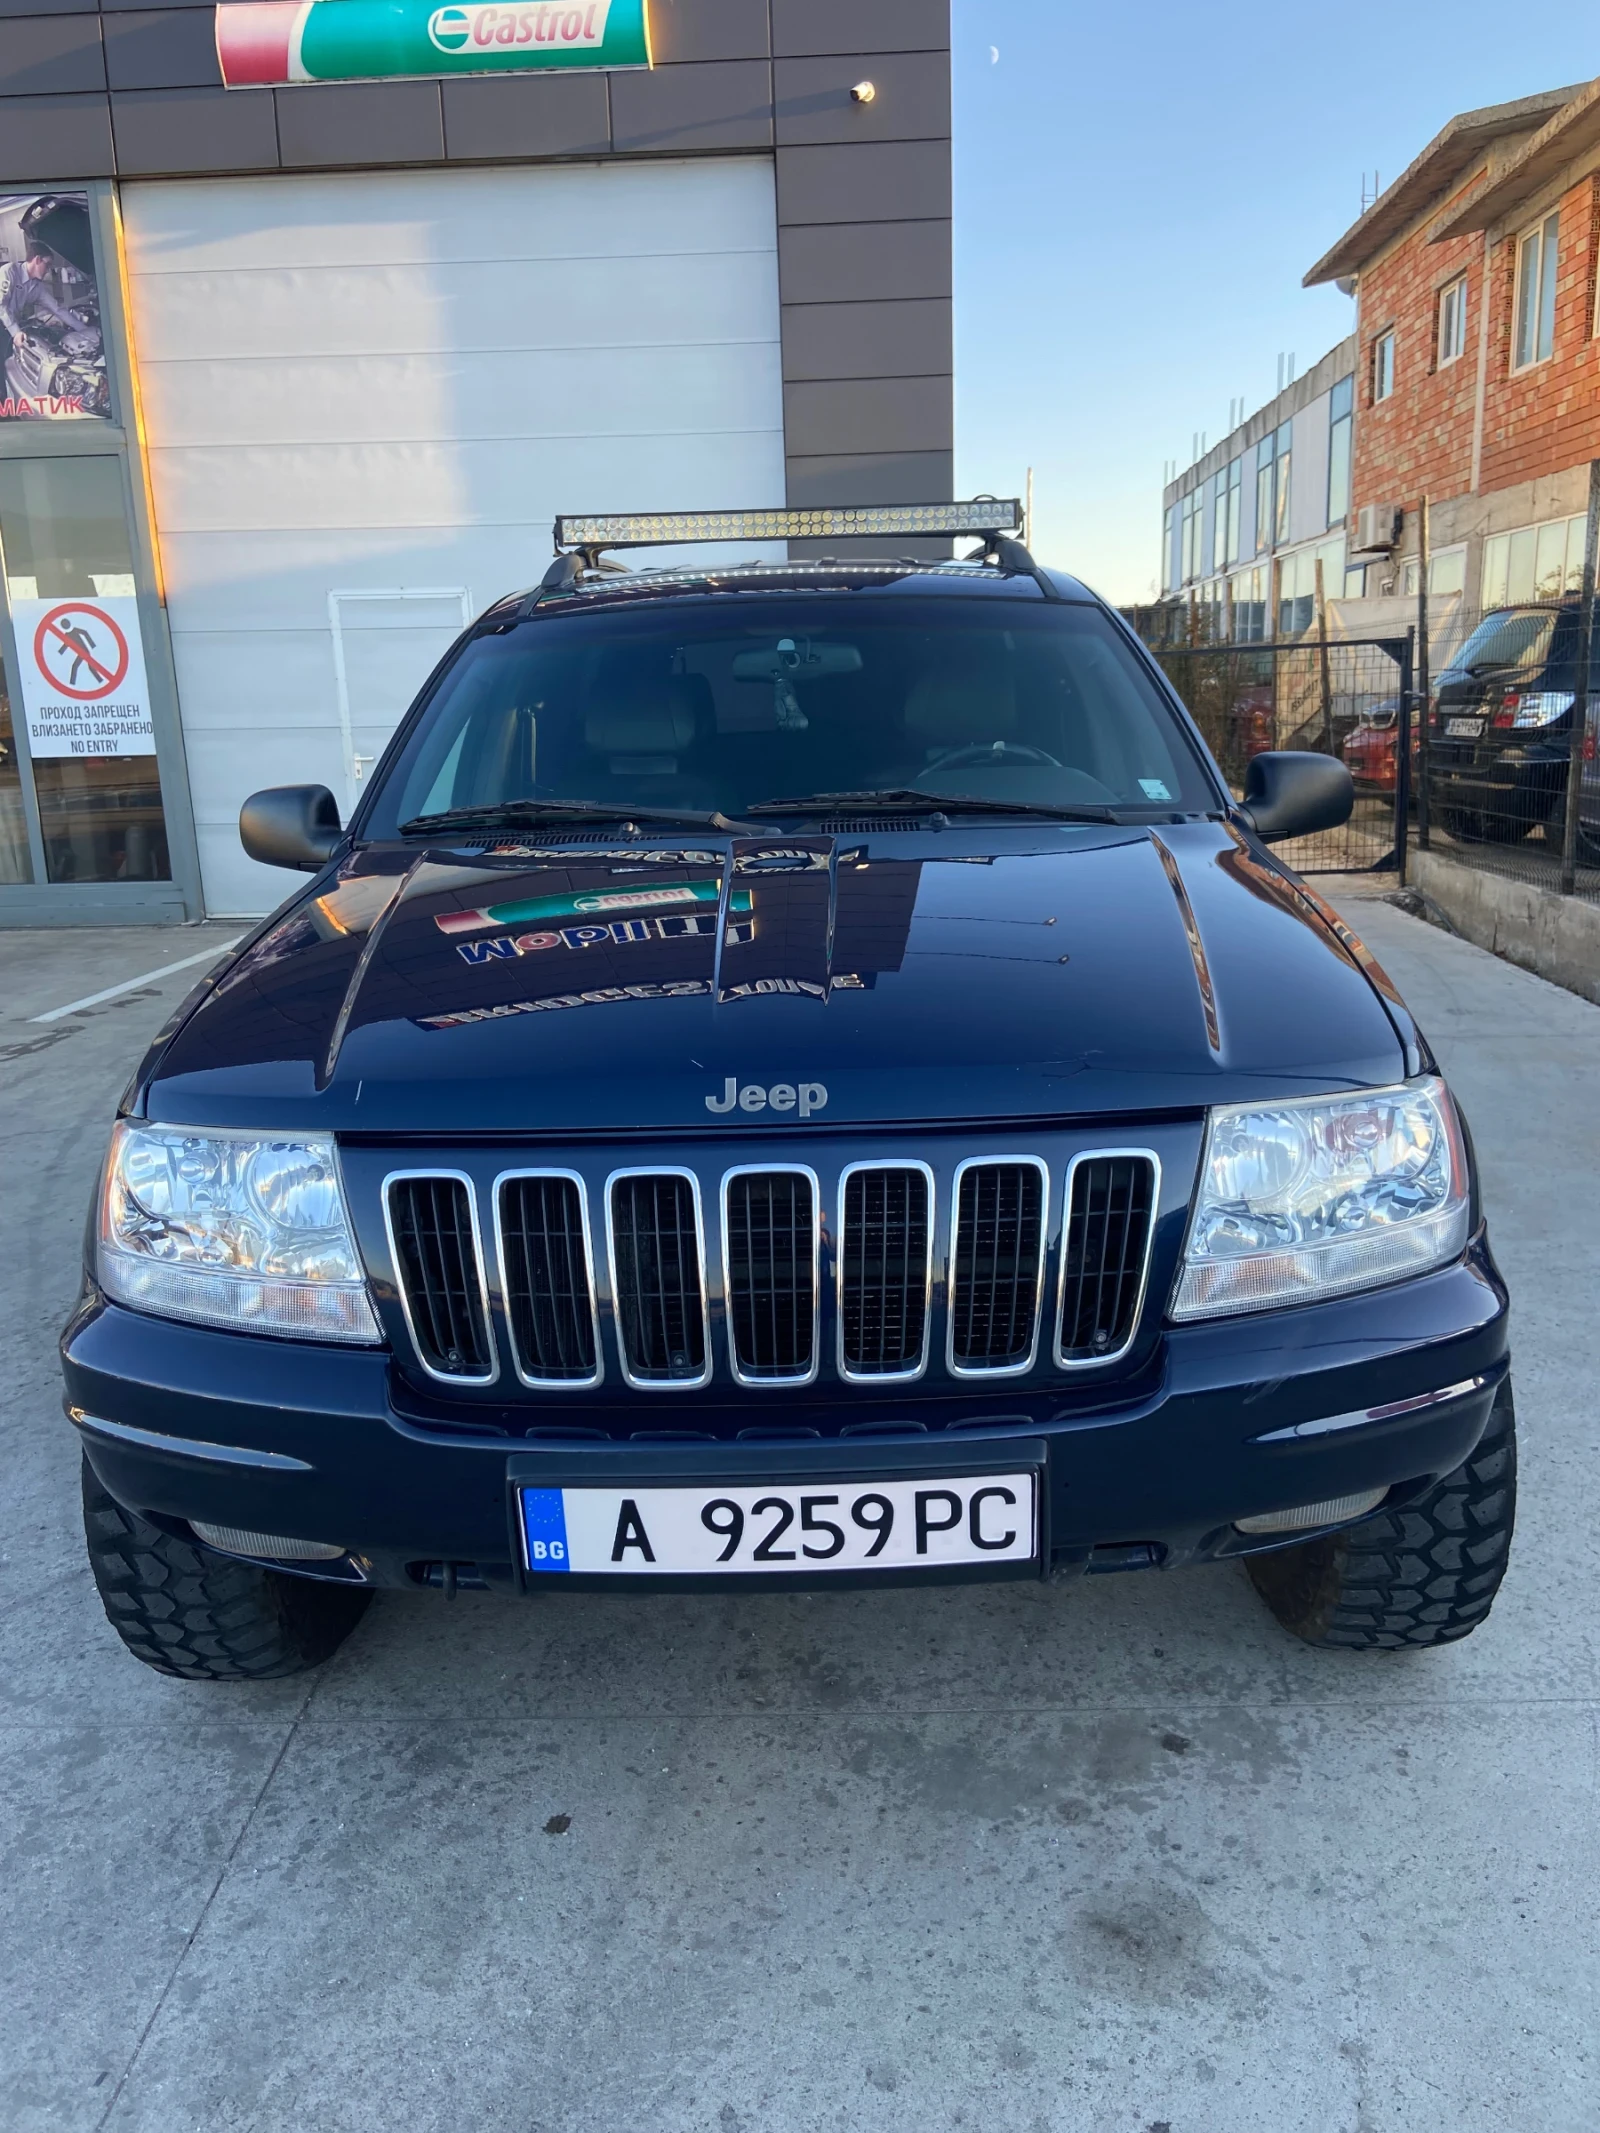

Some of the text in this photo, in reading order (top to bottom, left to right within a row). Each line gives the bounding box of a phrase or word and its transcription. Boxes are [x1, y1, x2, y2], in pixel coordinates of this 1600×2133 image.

[473, 3, 597, 46] Castrol
[40, 704, 140, 721] ПРОХОД ЗАПРЕЩЕН
[32, 721, 154, 738] ВЛИЗАНЕТО ЗАБРАНЕНО
[71, 739, 119, 753] NO ENTRY
[704, 1077, 828, 1118] Jeep
[700, 1492, 895, 1562] 9259
[533, 1541, 565, 1561] BG
